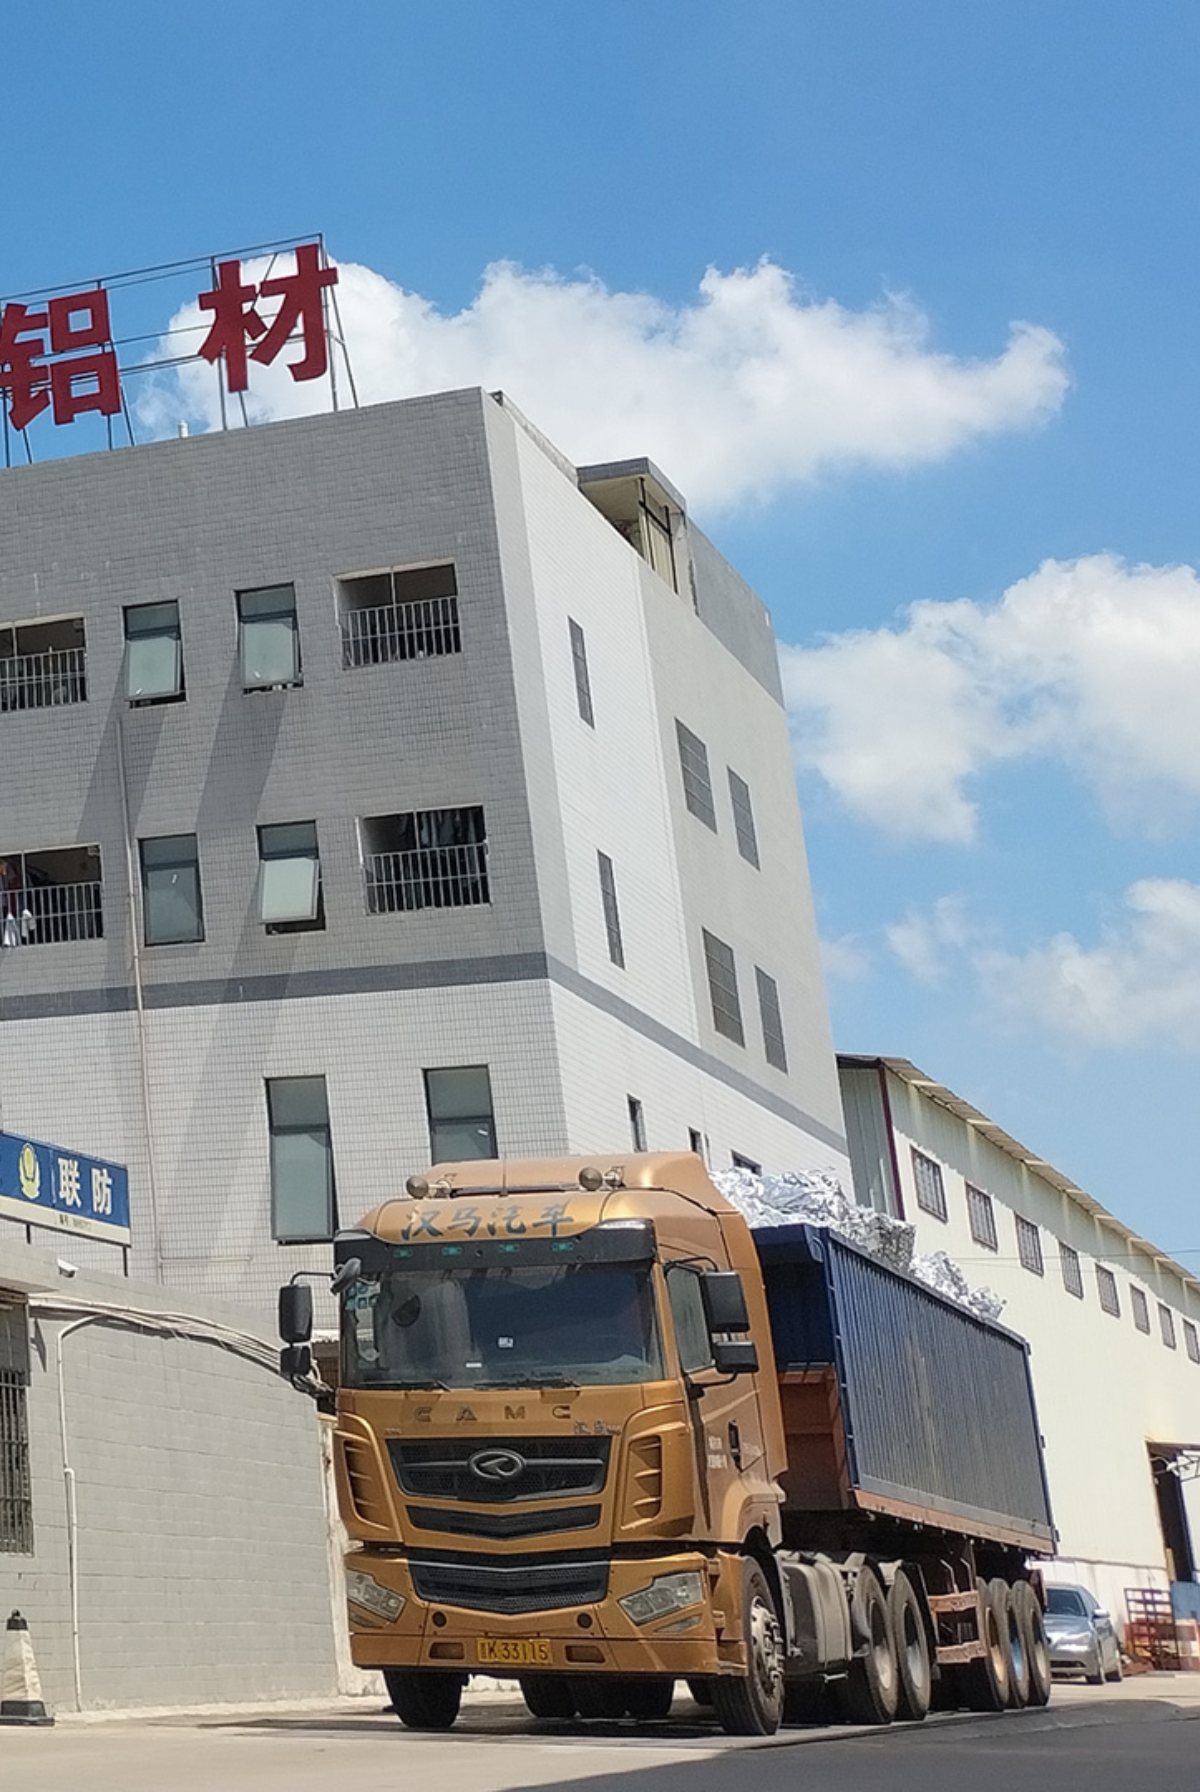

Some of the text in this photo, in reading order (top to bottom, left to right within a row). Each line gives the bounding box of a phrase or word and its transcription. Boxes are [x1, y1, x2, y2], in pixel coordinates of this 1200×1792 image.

[57, 1157, 113, 1216] 联防
[401, 1203, 575, 1241] 汉马汽车
[413, 1404, 572, 1423] CAMC
